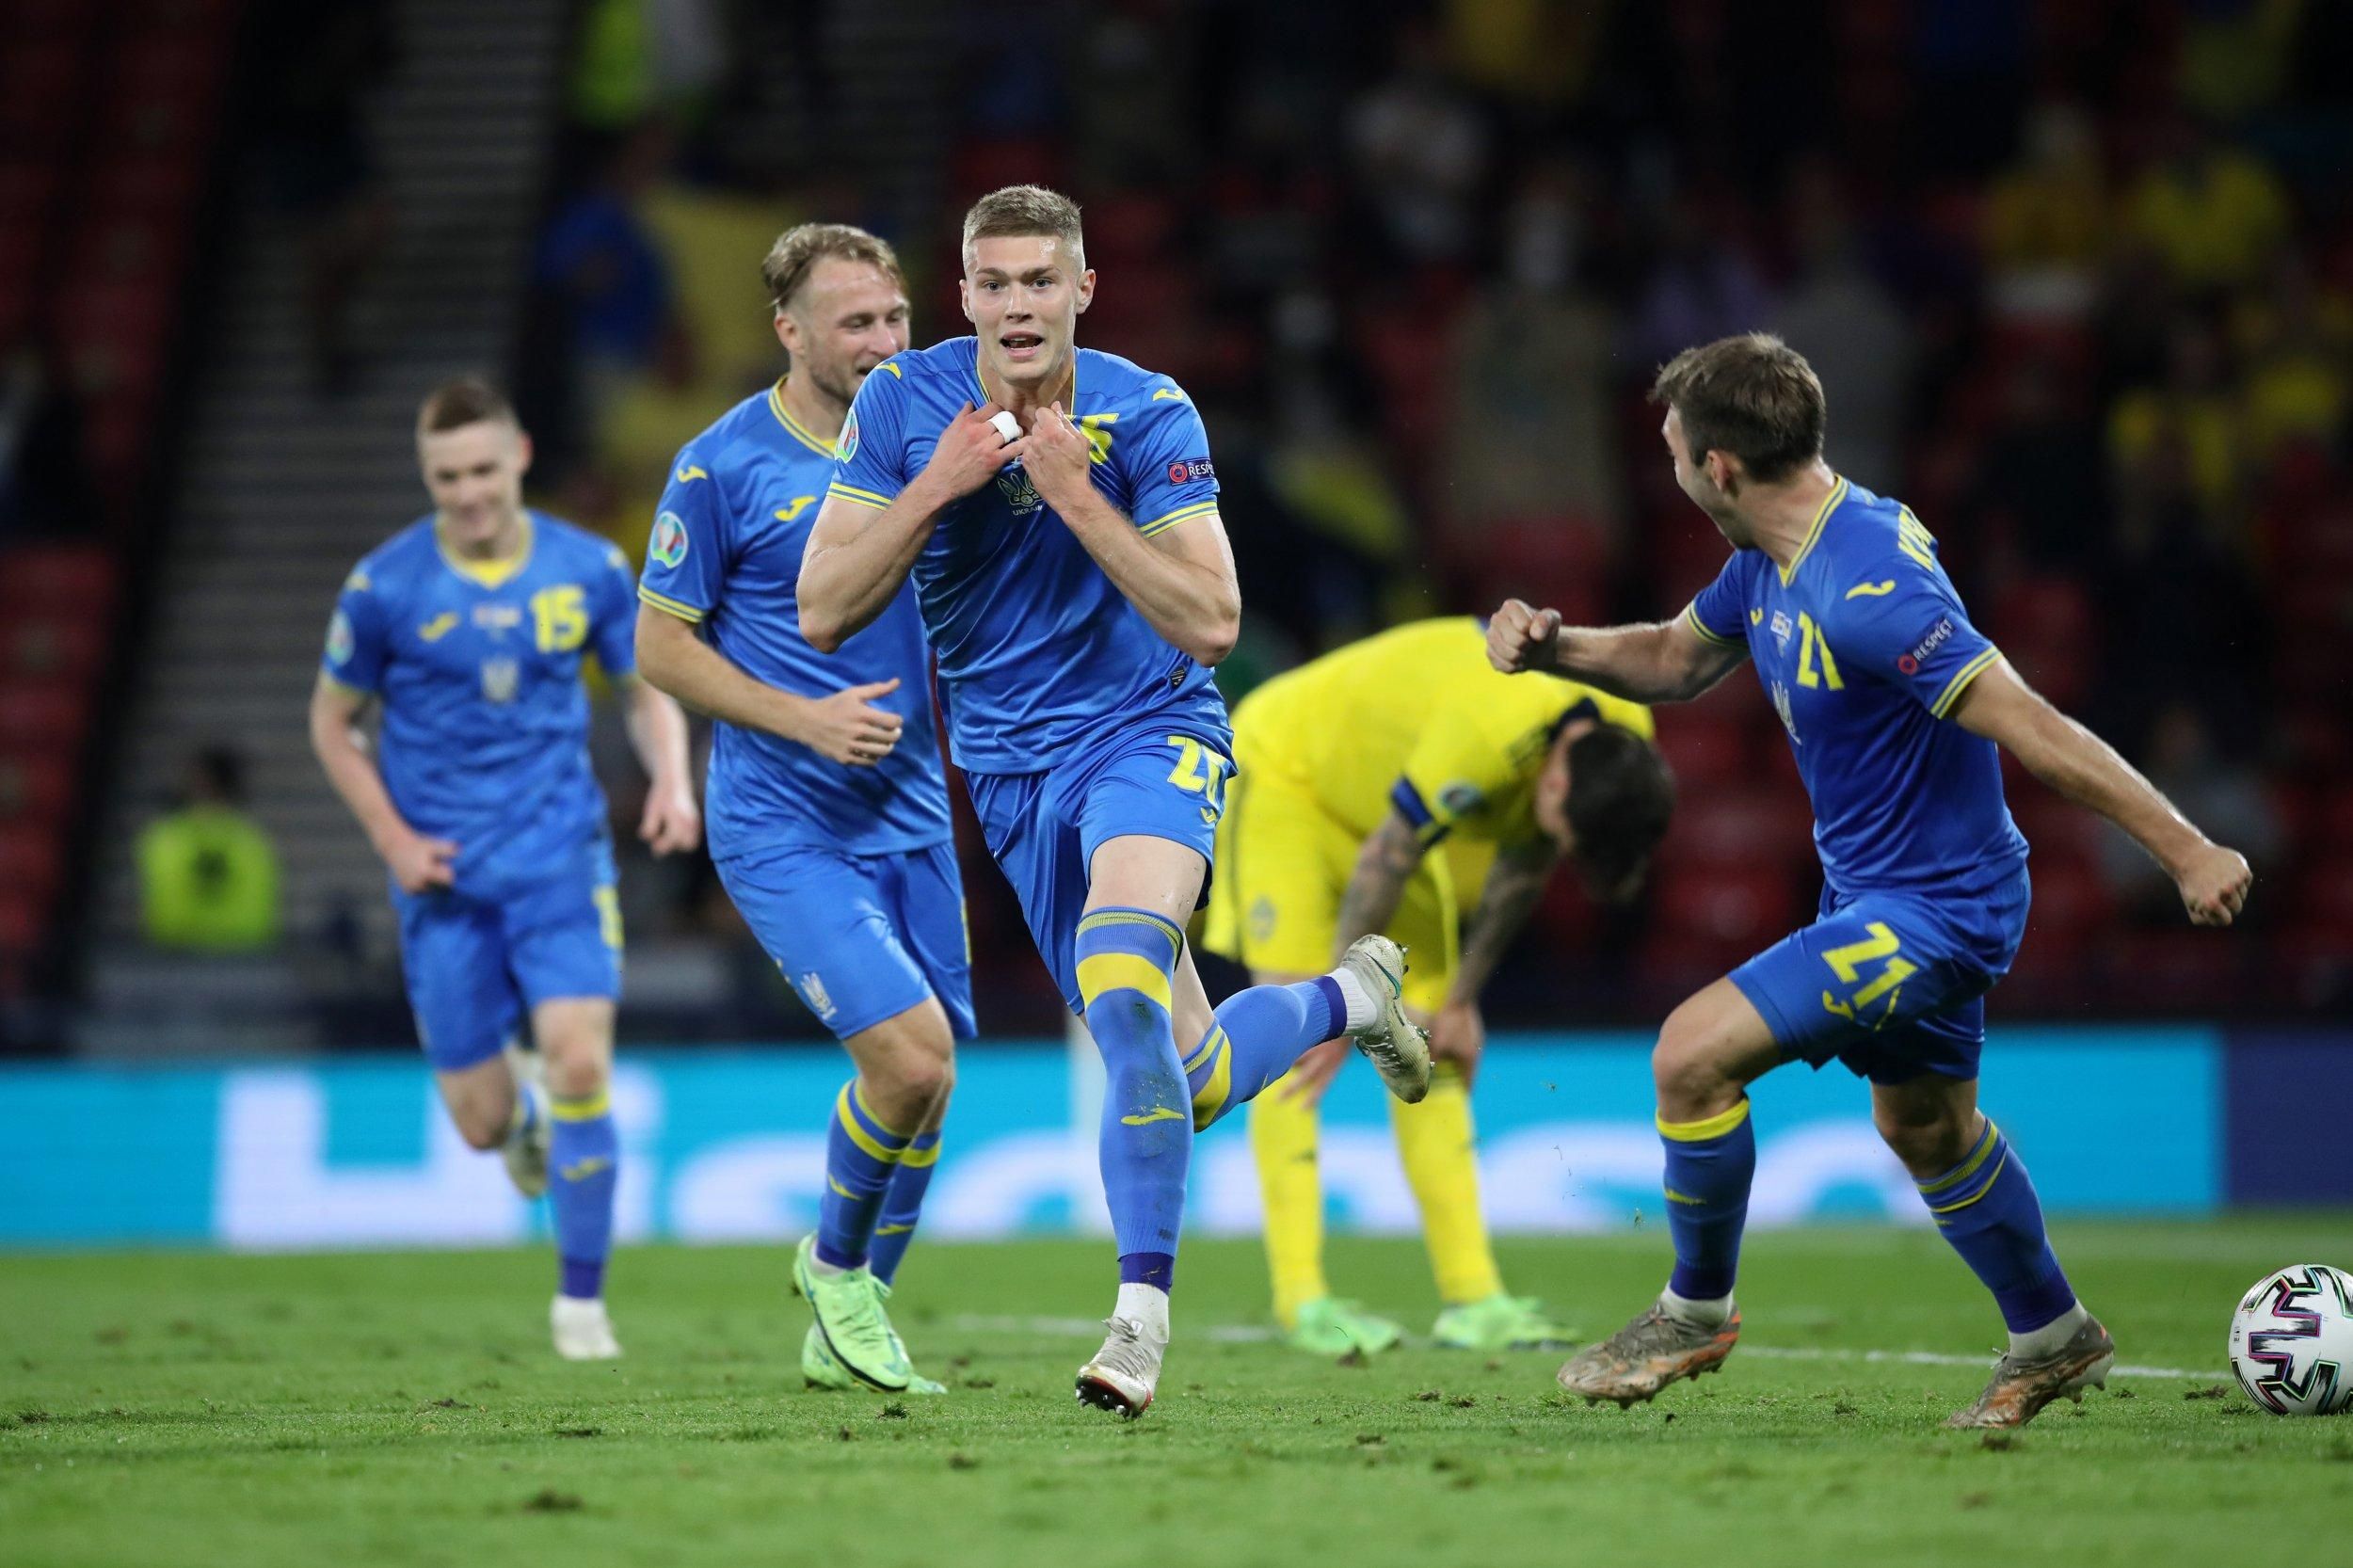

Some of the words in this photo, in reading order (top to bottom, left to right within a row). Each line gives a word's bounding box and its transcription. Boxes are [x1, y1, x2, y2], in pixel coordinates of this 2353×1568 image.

[1063, 412, 1119, 465] 5
[1188, 463, 1215, 476] RESP
[1012, 504, 1043, 516] UKRAIN
[529, 584, 588, 654] 15
[1913, 618, 1954, 662] RESPECT
[1796, 610, 1845, 691] 21
[1821, 920, 1918, 1010] 21
